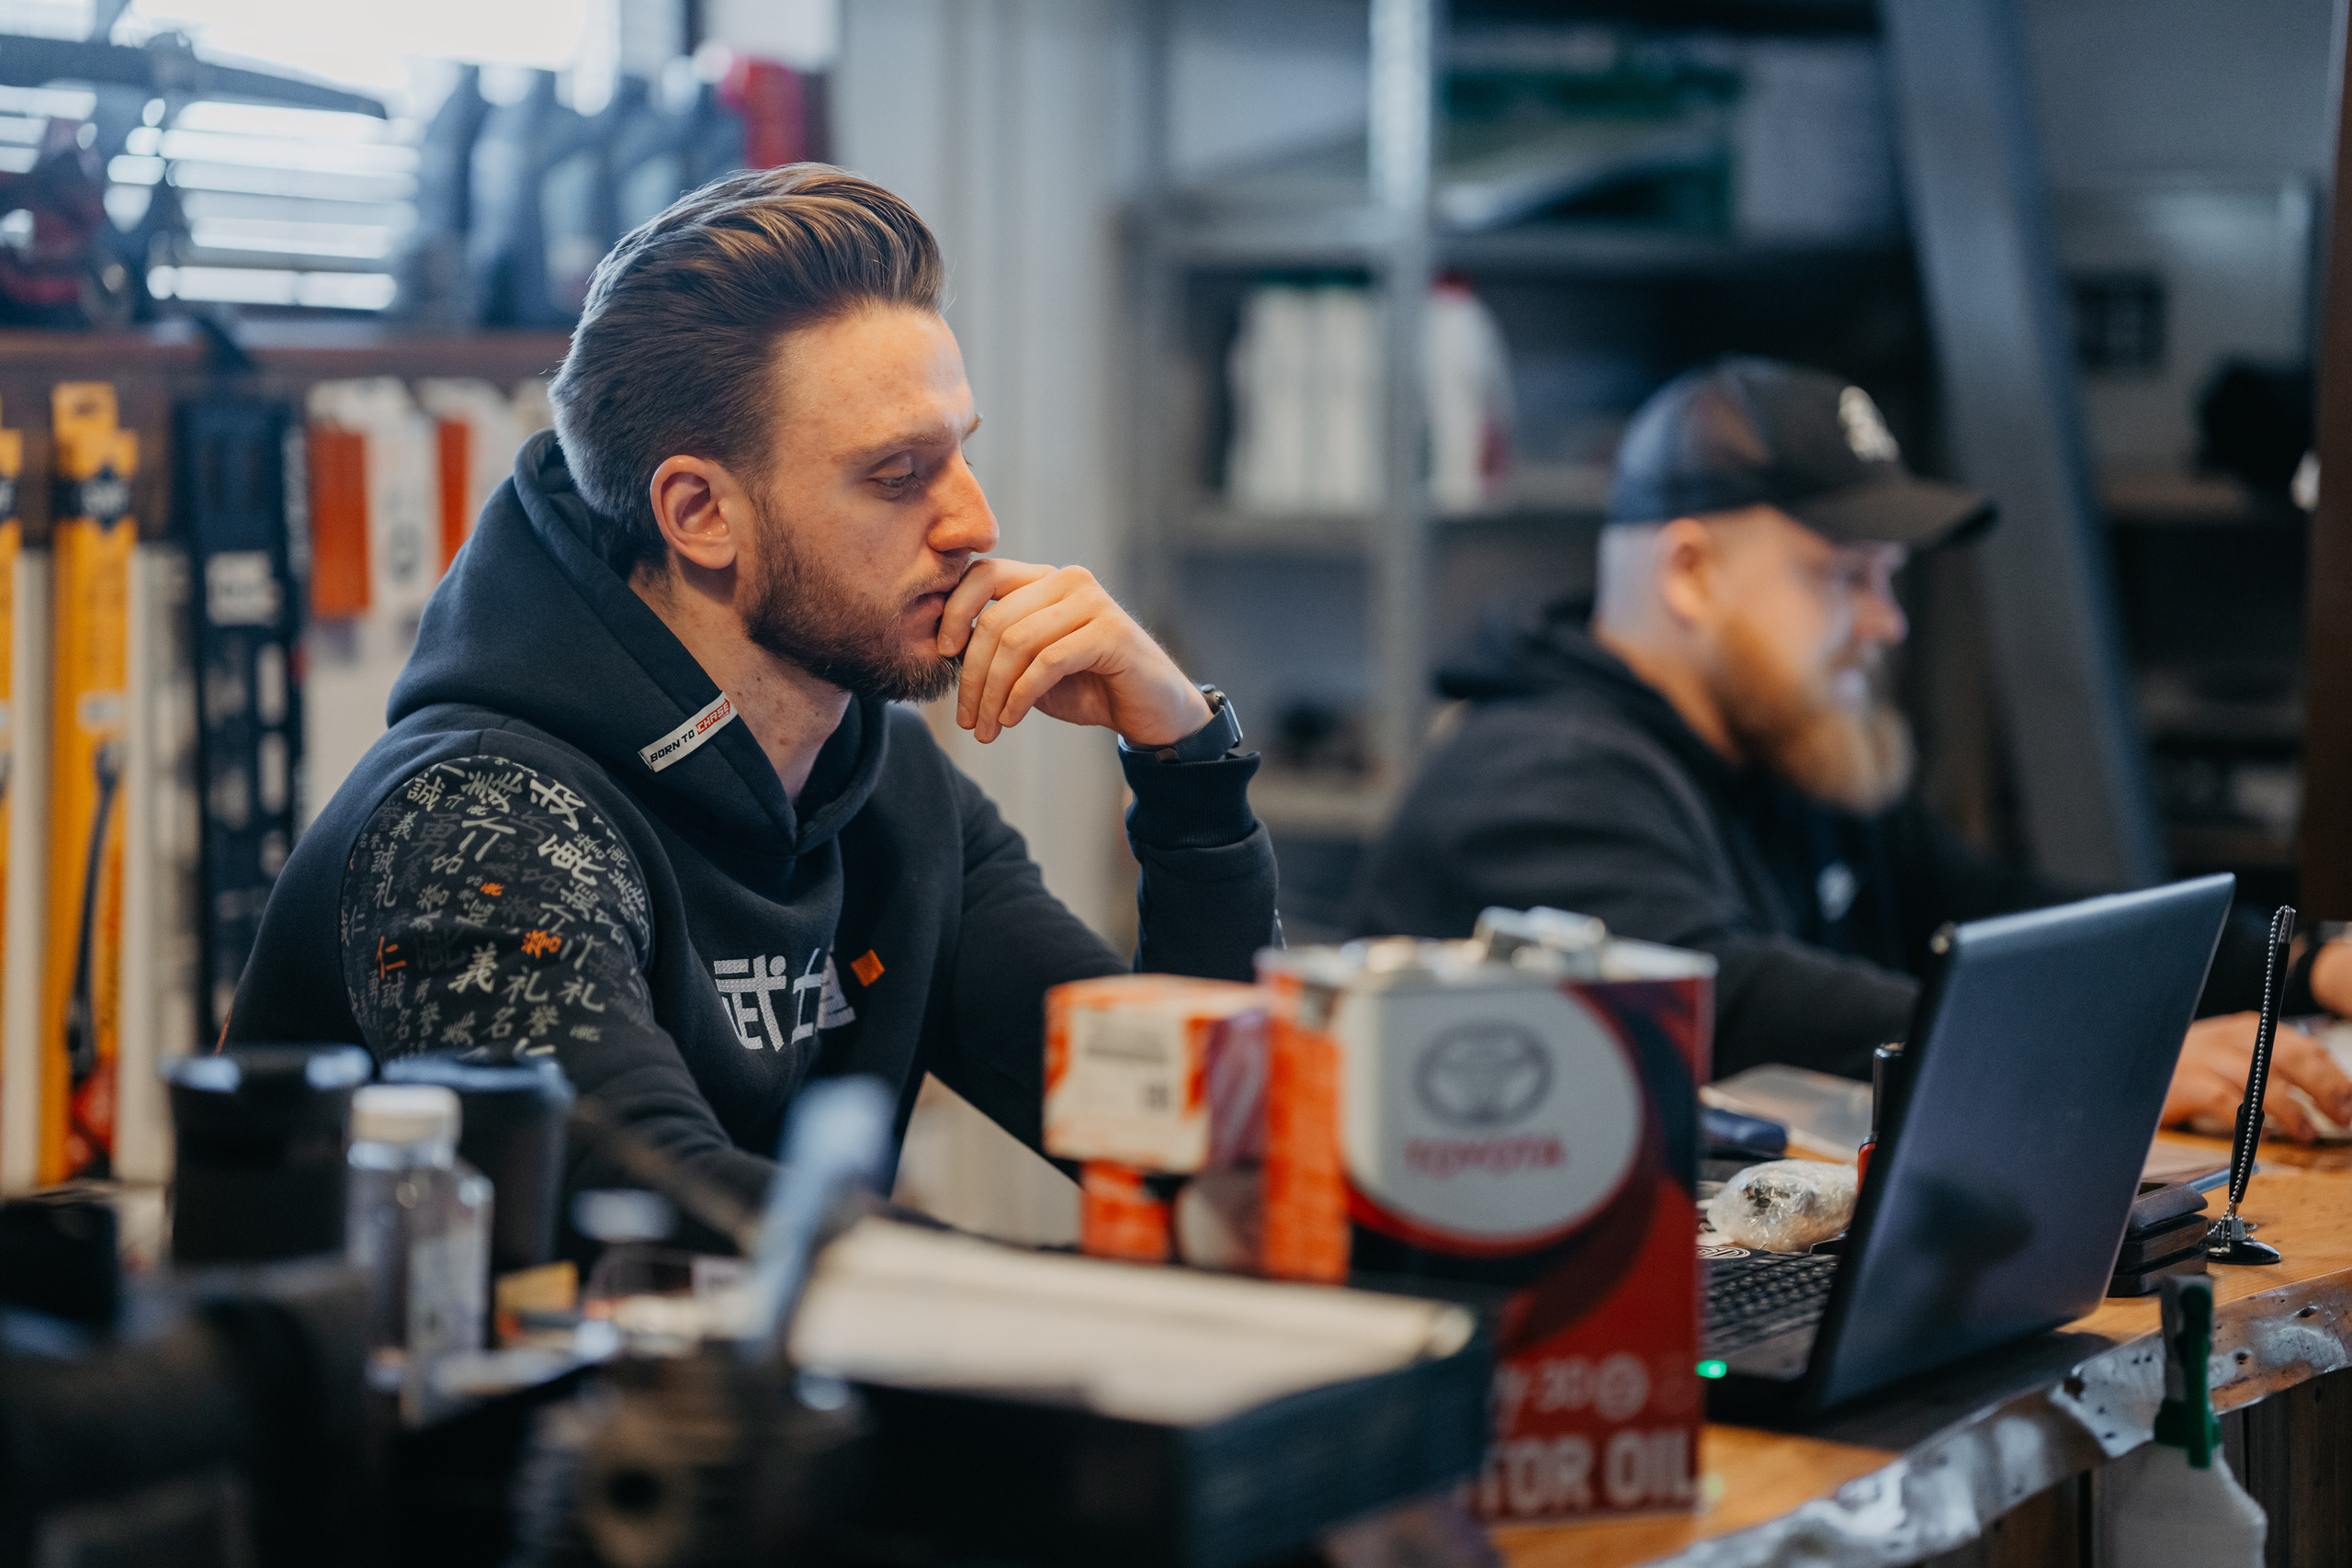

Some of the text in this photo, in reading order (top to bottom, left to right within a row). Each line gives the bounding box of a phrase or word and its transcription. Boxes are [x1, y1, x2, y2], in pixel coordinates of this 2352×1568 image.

[649, 700, 730, 763] BORN TO CHASE
[1605, 1427, 1696, 1505] OIL
